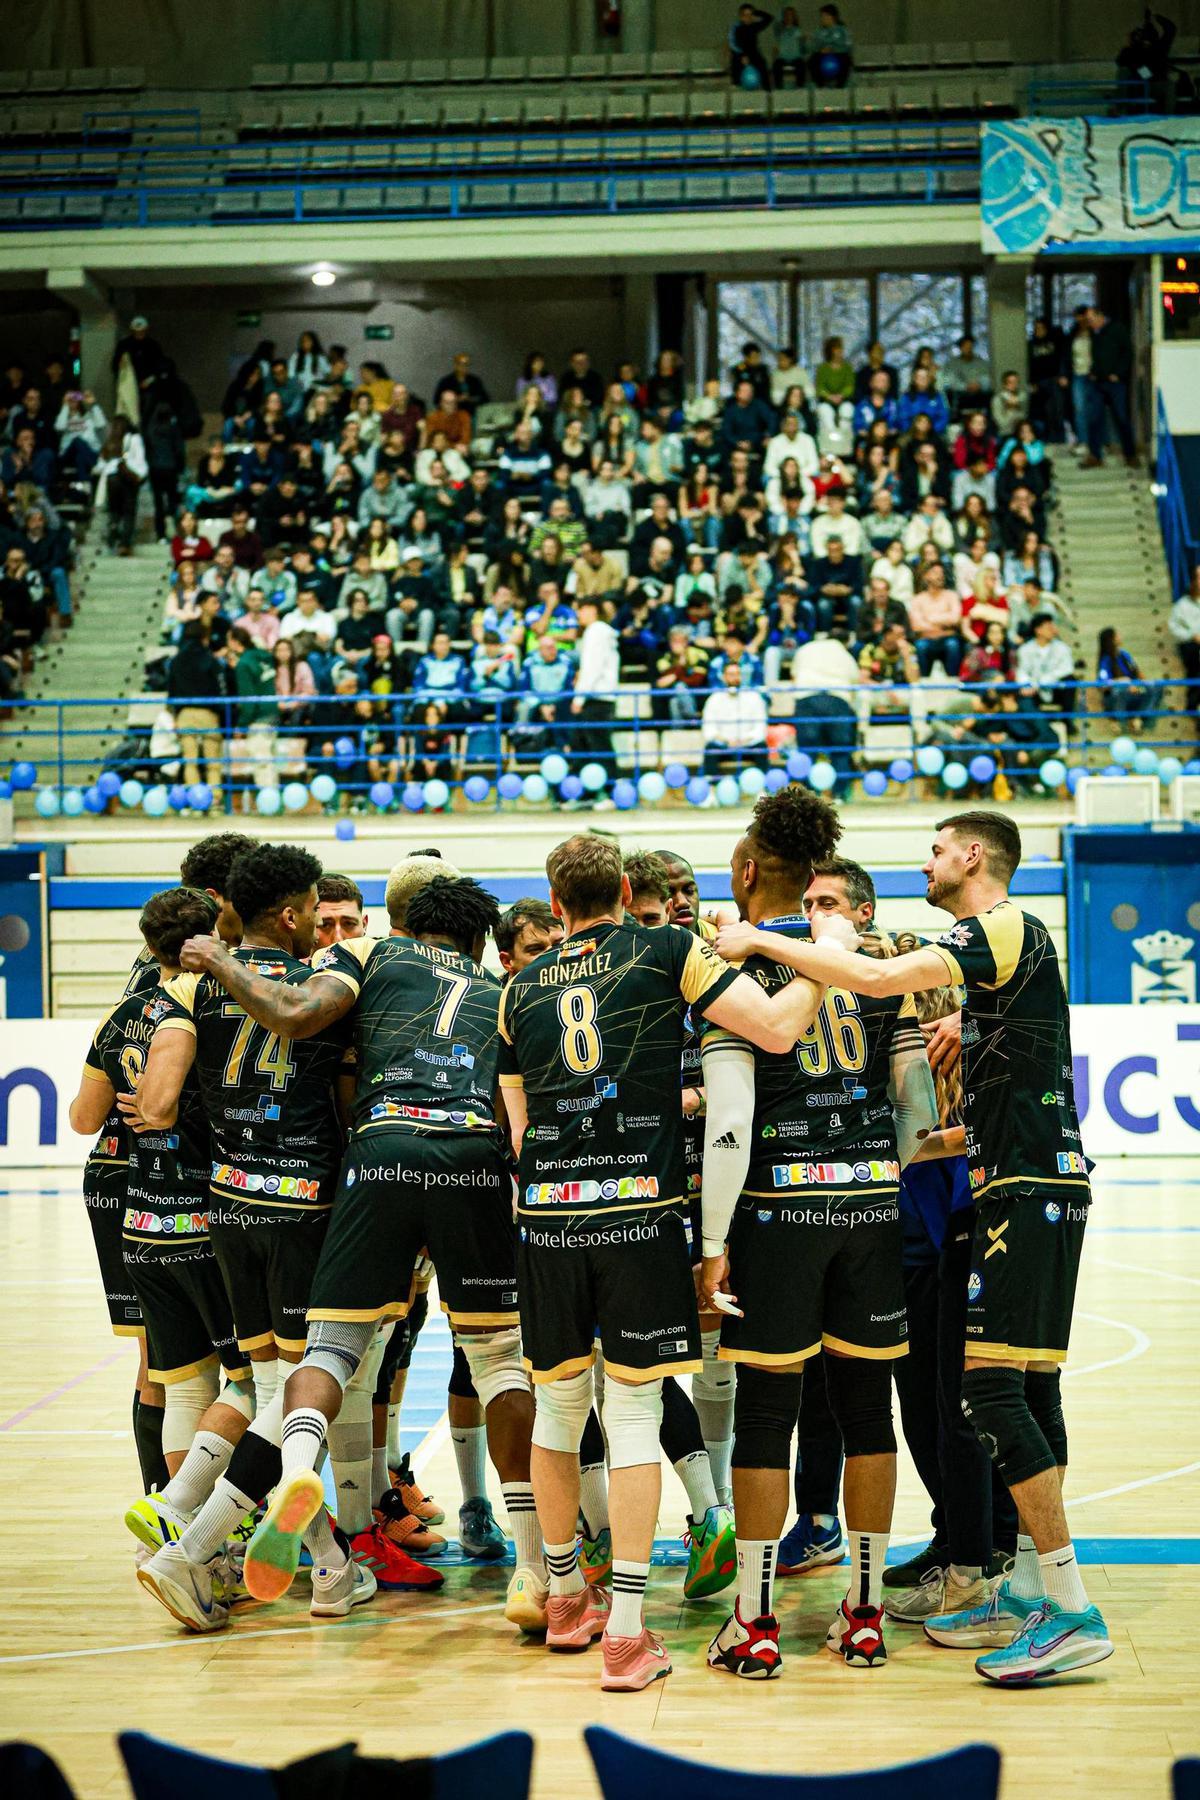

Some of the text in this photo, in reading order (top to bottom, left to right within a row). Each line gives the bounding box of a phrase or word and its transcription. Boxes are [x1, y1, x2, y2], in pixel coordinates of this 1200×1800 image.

[413, 943, 467, 972] MIGUEL
[539, 952, 612, 987] GONZÁLEZ
[432, 965, 472, 1039] 7
[124, 1018, 156, 1042] GONZ
[557, 984, 603, 1076] 8
[796, 985, 868, 1078] 96
[221, 1002, 296, 1092] 74
[414, 1048, 461, 1068] suma
[557, 1094, 603, 1113] suma
[806, 1092, 851, 1107] suma
[224, 1107, 264, 1123] suma
[777, 1125, 809, 1133] TRINIDAD
[778, 1130, 809, 1138] ALFONSO
[712, 1142, 740, 1150] adidas
[535, 1153, 648, 1171] benicolchon.com
[772, 1160, 900, 1188] BENIDORM
[1056, 1151, 1088, 1174] BEN
[211, 1160, 320, 1201] BENIDORM
[525, 1176, 660, 1206] BENIDORM
[123, 1207, 210, 1234] ENIDORM
